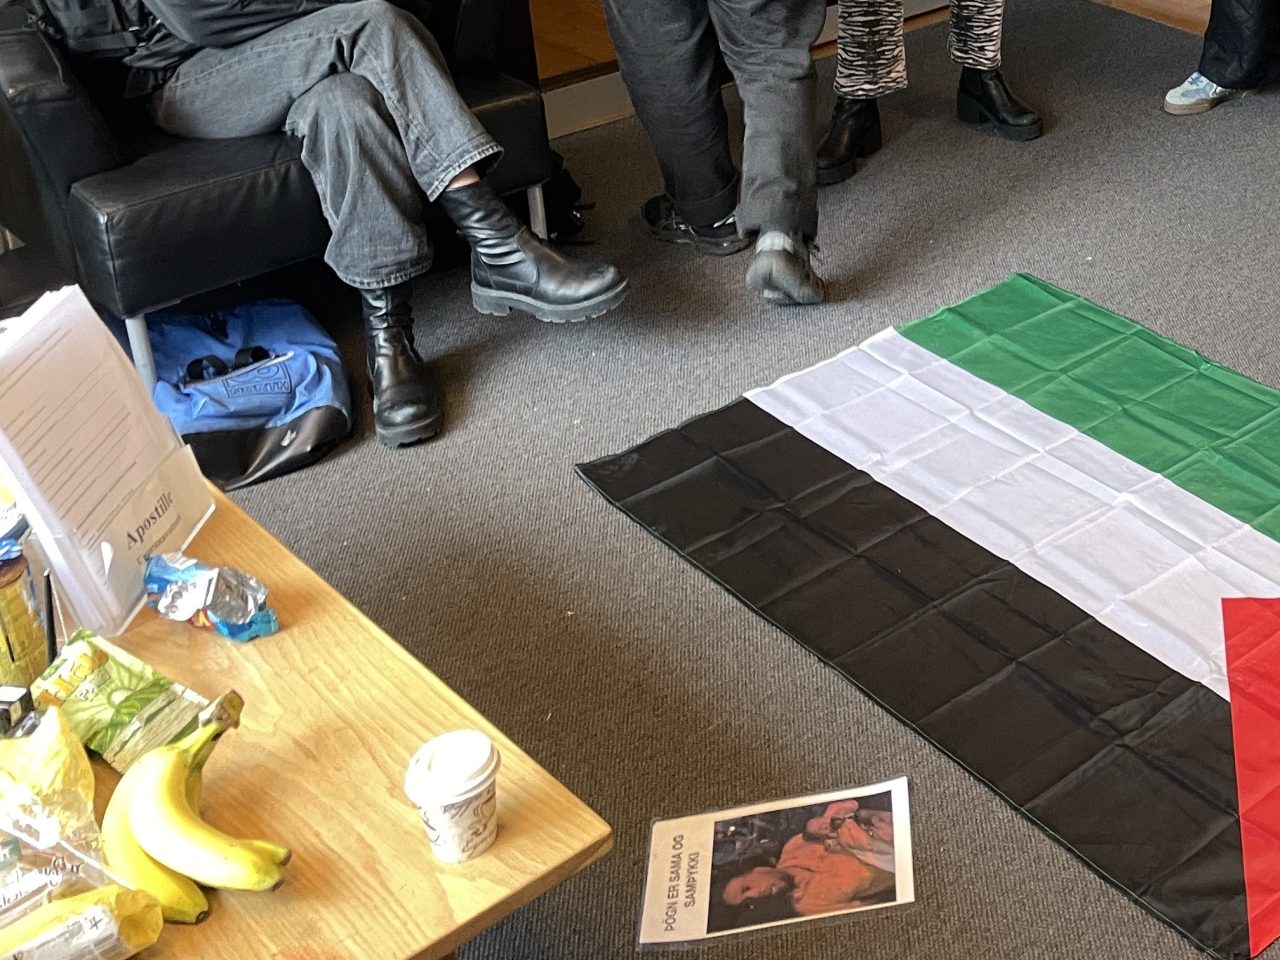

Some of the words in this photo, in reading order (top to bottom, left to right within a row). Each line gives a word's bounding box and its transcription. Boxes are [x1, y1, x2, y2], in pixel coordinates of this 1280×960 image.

[127, 491, 173, 551] Apostille
[672, 834, 684, 851] OG
[669, 852, 682, 883] SAMA
[668, 882, 679, 900] ER
